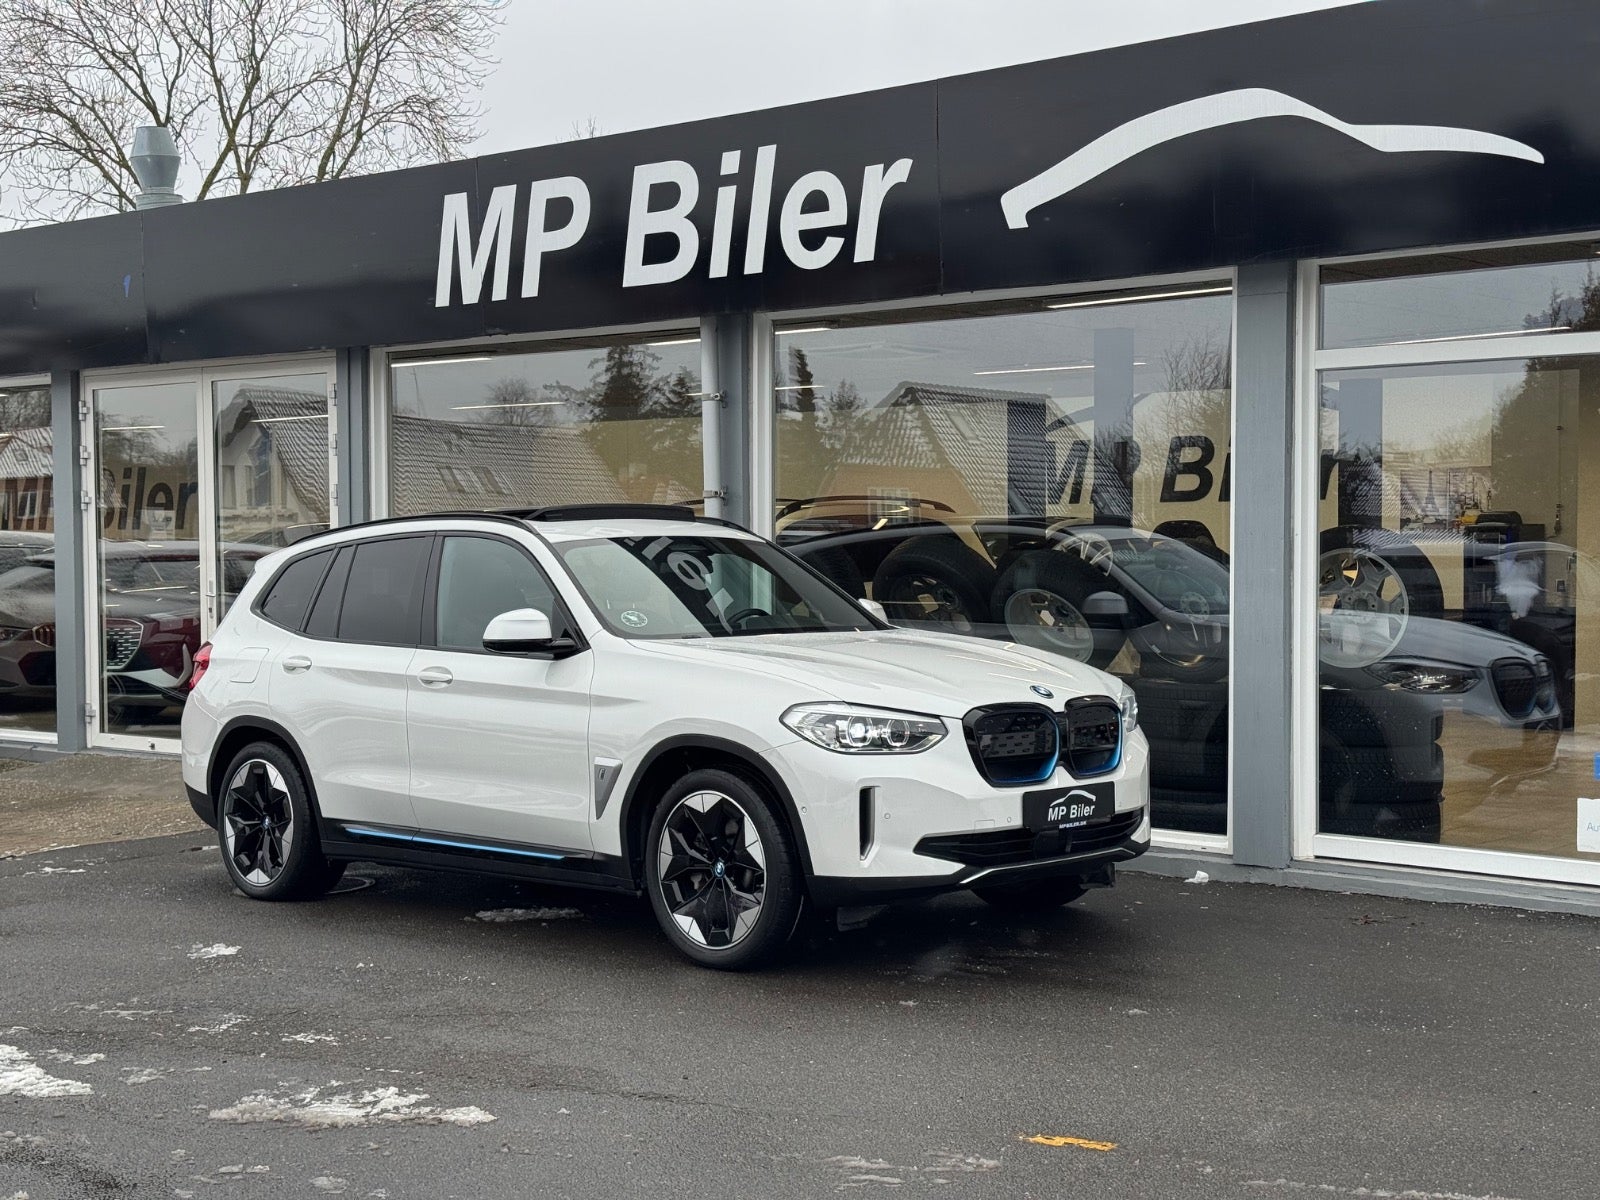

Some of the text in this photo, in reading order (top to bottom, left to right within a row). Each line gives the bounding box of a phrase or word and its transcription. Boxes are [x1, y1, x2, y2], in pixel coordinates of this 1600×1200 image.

[434, 144, 913, 308] MP Biler
[1047, 803, 1096, 822] MP Biler
